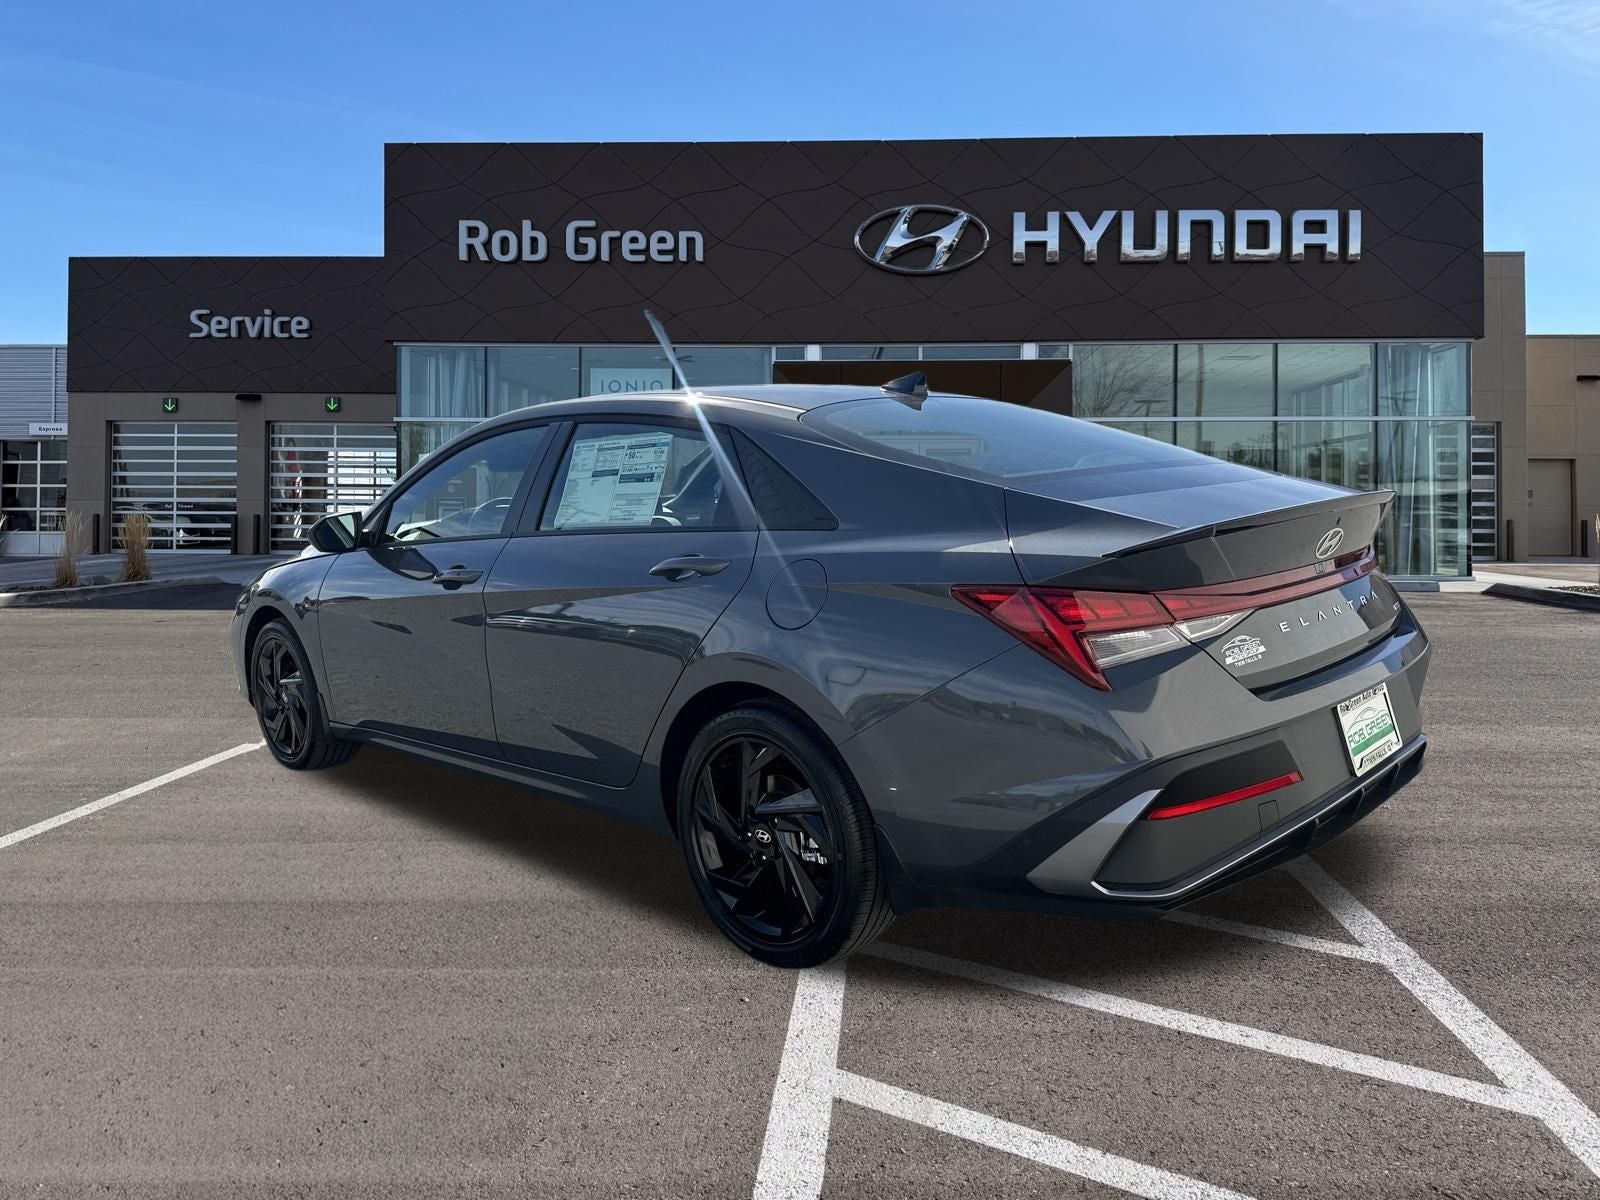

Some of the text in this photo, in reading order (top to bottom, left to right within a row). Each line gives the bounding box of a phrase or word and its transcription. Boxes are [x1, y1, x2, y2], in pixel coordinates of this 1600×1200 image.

[458, 219, 705, 263] Rob Green
[1011, 209, 1362, 264] HYUNDAI
[188, 308, 310, 339] Service
[1279, 592, 1378, 633] ELANTRA
[1225, 640, 1261, 657] ROB GREEN
[1347, 713, 1390, 748] ROB GREEN
